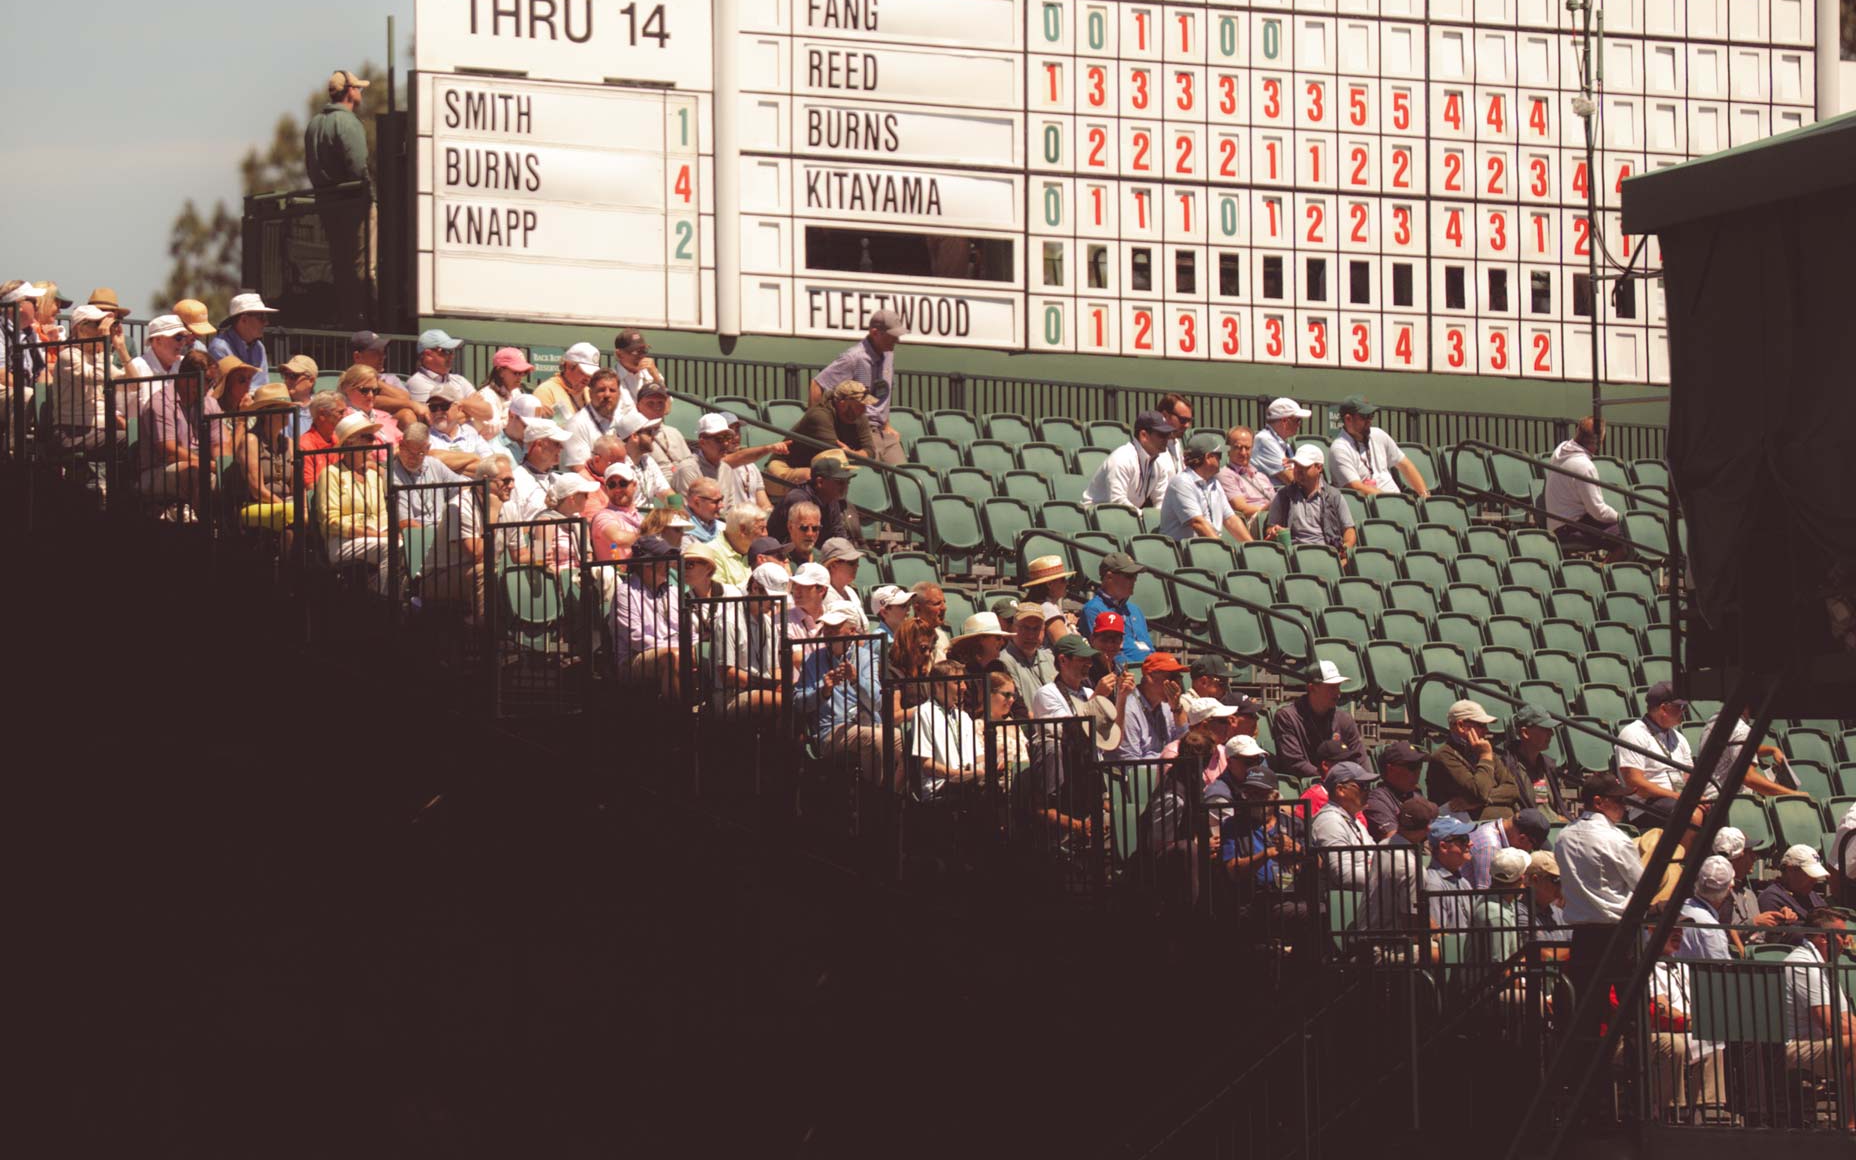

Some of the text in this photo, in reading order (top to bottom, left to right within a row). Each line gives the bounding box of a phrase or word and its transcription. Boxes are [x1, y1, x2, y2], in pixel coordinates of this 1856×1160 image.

[620, 2, 671, 48] 14
[1043, 3, 1060, 43] 0
[1089, 13, 1104, 50] 0
[1135, 13, 1146, 51] 1
[1178, 14, 1189, 53] 1
[1220, 18, 1235, 56] 0
[1263, 23, 1279, 59] 0
[445, 88, 688, 146] SMITH 1
[808, 48, 1547, 137] REED 1 3 3 3 3 3 3 5 5 4 4 4
[446, 147, 692, 203] BURNS 4
[807, 108, 899, 152] BURNS
[1045, 125, 1060, 164] 0
[1088, 127, 1106, 167] 2
[1132, 132, 1150, 172] 2
[1175, 135, 1193, 175] 2
[1219, 138, 1237, 178] 2
[1265, 142, 1277, 180] 1
[1308, 145, 1320, 183] 1
[1350, 147, 1368, 186] 2
[1392, 149, 1409, 189] 2
[1443, 152, 1462, 192] 2
[1487, 156, 1505, 195] 2
[1530, 158, 1548, 198] 3
[1571, 161, 1589, 200] 4
[446, 204, 693, 260] KNAPP 2
[806, 169, 942, 216] KITAYAMA
[1045, 188, 1060, 226] 0
[1091, 187, 1102, 226] 1
[1134, 192, 1146, 229] 1
[1179, 194, 1191, 233] 1
[1221, 199, 1237, 236] 0
[1265, 200, 1277, 238] 1
[1305, 204, 1324, 244] 2
[1350, 203, 1368, 244] 2
[1392, 207, 1411, 246] 3
[1445, 209, 1463, 248] 4
[1489, 212, 1507, 252] 3
[1532, 215, 1545, 254] 1
[1573, 217, 1591, 257] 2
[1045, 307, 1061, 345] 0
[1091, 308, 1103, 348] 1
[1134, 311, 1153, 351] 2
[1178, 313, 1196, 354] 3
[1221, 316, 1240, 356] 3
[1265, 317, 1283, 358] 3
[1307, 321, 1327, 360] 3
[1351, 323, 1370, 363] 3
[1394, 326, 1413, 365] 4
[1446, 328, 1465, 369] 3
[1489, 331, 1508, 371] 3
[1532, 333, 1551, 373] 2
